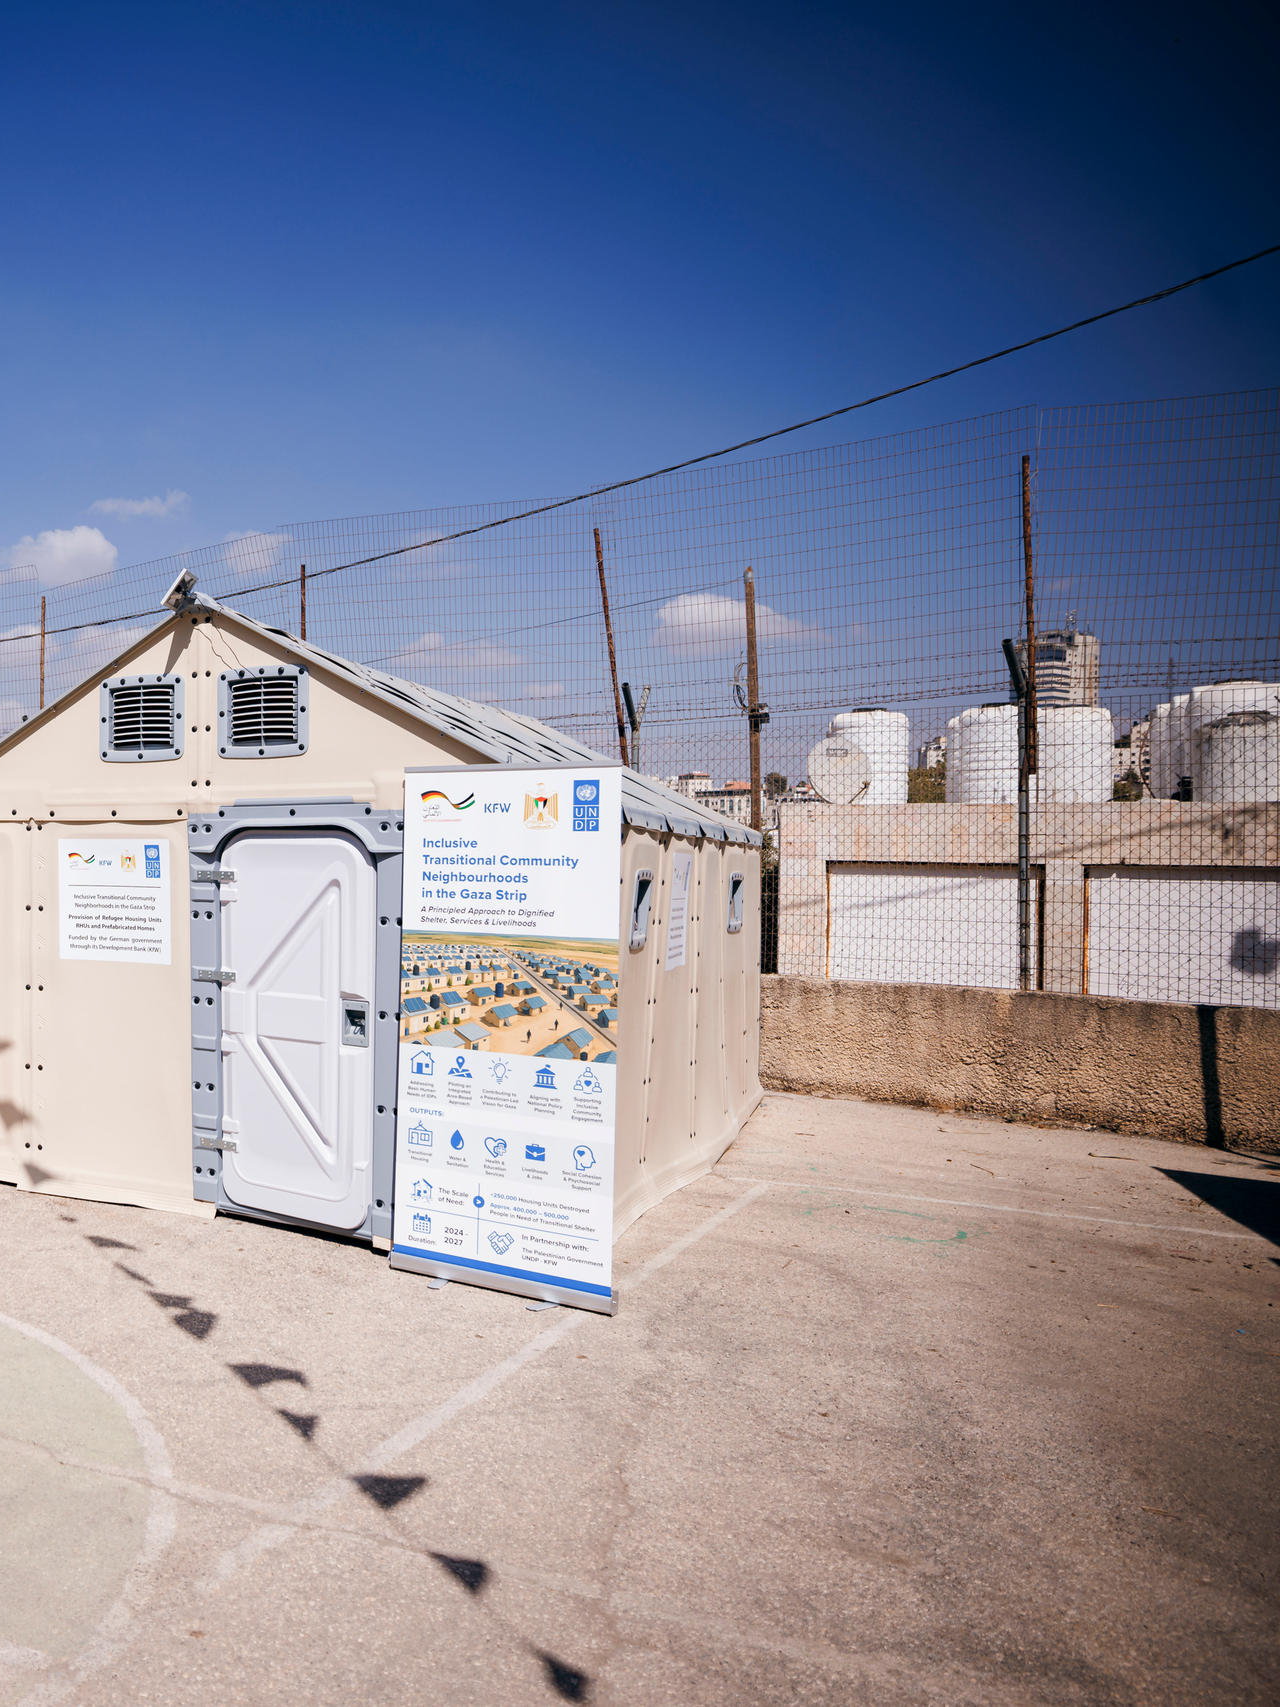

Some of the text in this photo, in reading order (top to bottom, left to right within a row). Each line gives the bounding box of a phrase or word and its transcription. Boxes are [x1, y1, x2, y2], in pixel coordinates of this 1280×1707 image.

[484, 803, 511, 813] KFW
[423, 837, 478, 848] Inclusive
[422, 854, 579, 869] Transitional Community
[422, 871, 528, 884] Neighbourhoods
[422, 888, 527, 903] in the Gaza Strip
[428, 906, 466, 916] Principled
[468, 907, 506, 916] Approach
[518, 909, 555, 918] Dignified
[421, 916, 448, 924] Shelter,
[450, 917, 482, 925] Services
[492, 919, 537, 927] Livelihoods
[482, 1089, 511, 1097] Contributing
[574, 1097, 601, 1105] Supporting
[522, 1167, 548, 1175] Livelihoods
[568, 1178, 600, 1186] Psychosocial
[446, 1198, 464, 1206] Need:
[518, 1197, 541, 1206] Housing
[542, 1201, 558, 1209] Units
[559, 1204, 589, 1214] Destroyed
[489, 1210, 508, 1218] People
[516, 1214, 531, 1222] Need
[540, 1219, 573, 1229] Transitional
[574, 1224, 595, 1233] Shelter
[444, 1226, 463, 1236] 2024
[444, 1237, 463, 1245] 2027
[530, 1235, 570, 1249] Partnership
[572, 1244, 589, 1252] with:
[534, 1249, 565, 1260] Palestinian
[567, 1256, 603, 1267] Government
